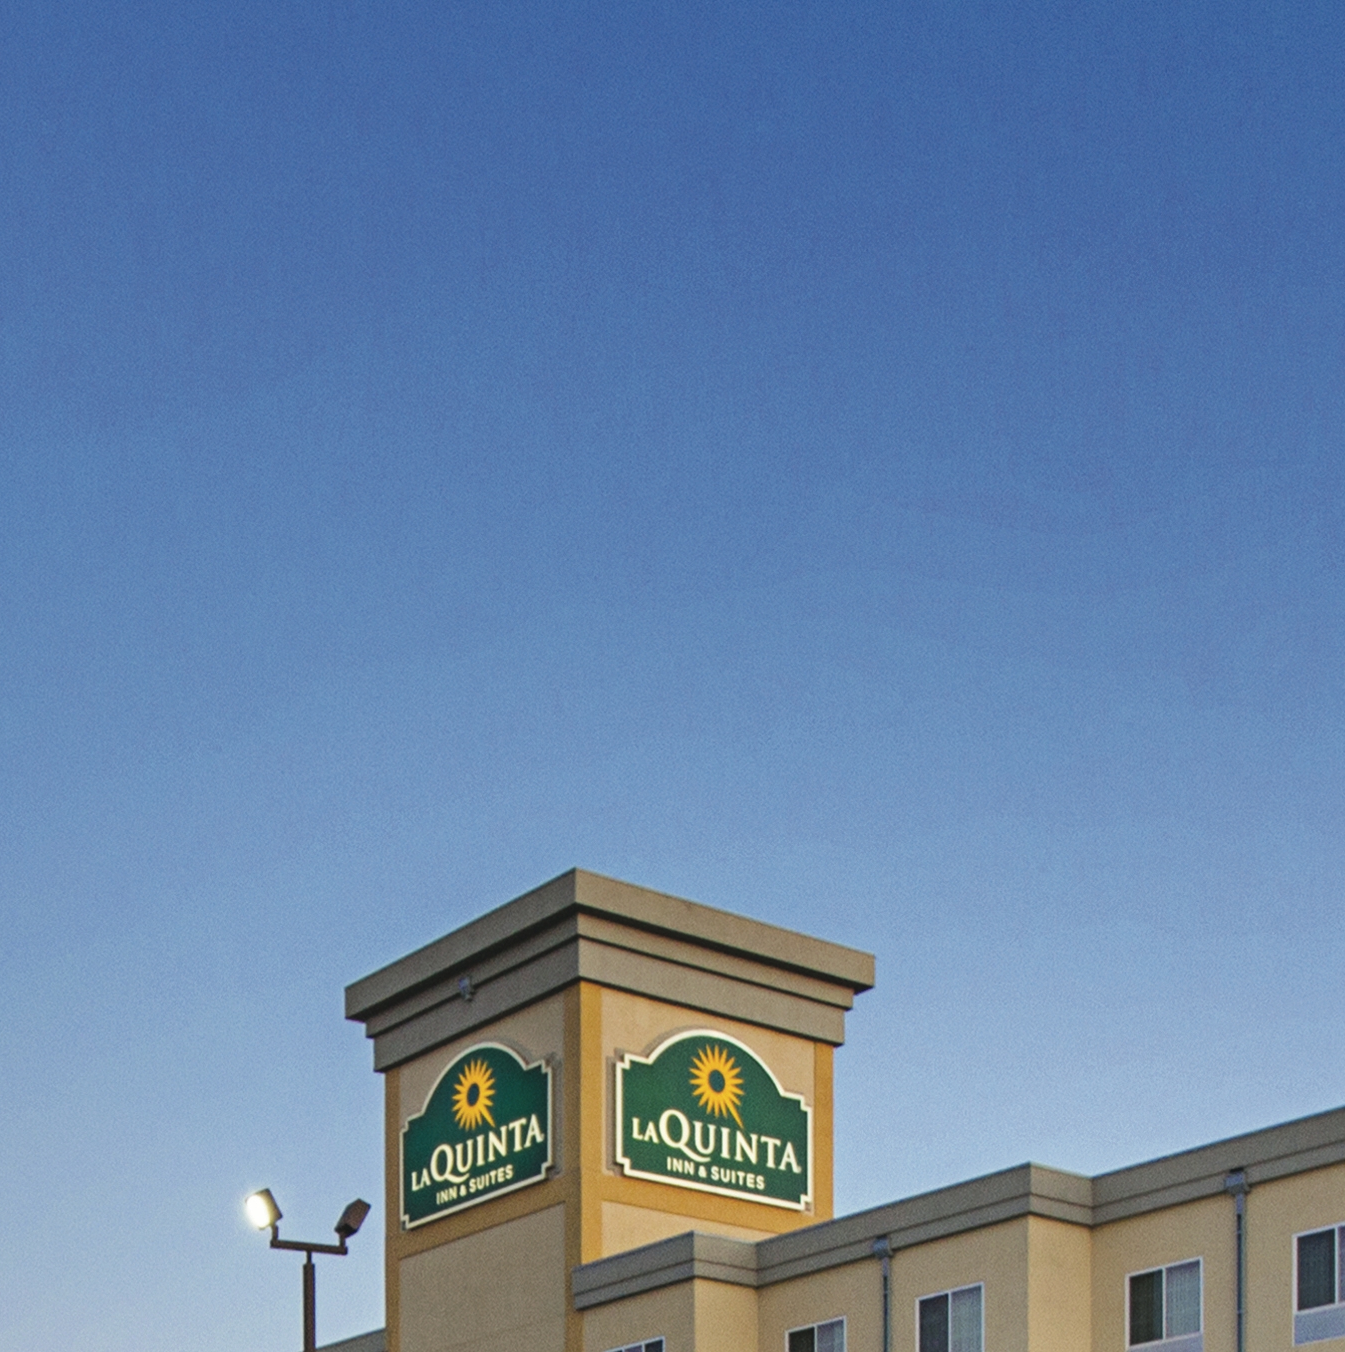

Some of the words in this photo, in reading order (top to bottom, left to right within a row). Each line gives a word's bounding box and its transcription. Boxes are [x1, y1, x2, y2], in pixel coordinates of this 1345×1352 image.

[430, 1113, 544, 1183] QUINTA
[659, 1109, 802, 1174] QUINTA
[436, 1186, 458, 1205] INN
[459, 1184, 467, 1197] &
[469, 1164, 514, 1193] SUITES
[667, 1157, 695, 1175] INN
[698, 1166, 707, 1178] &
[711, 1166, 765, 1190] SUITES
